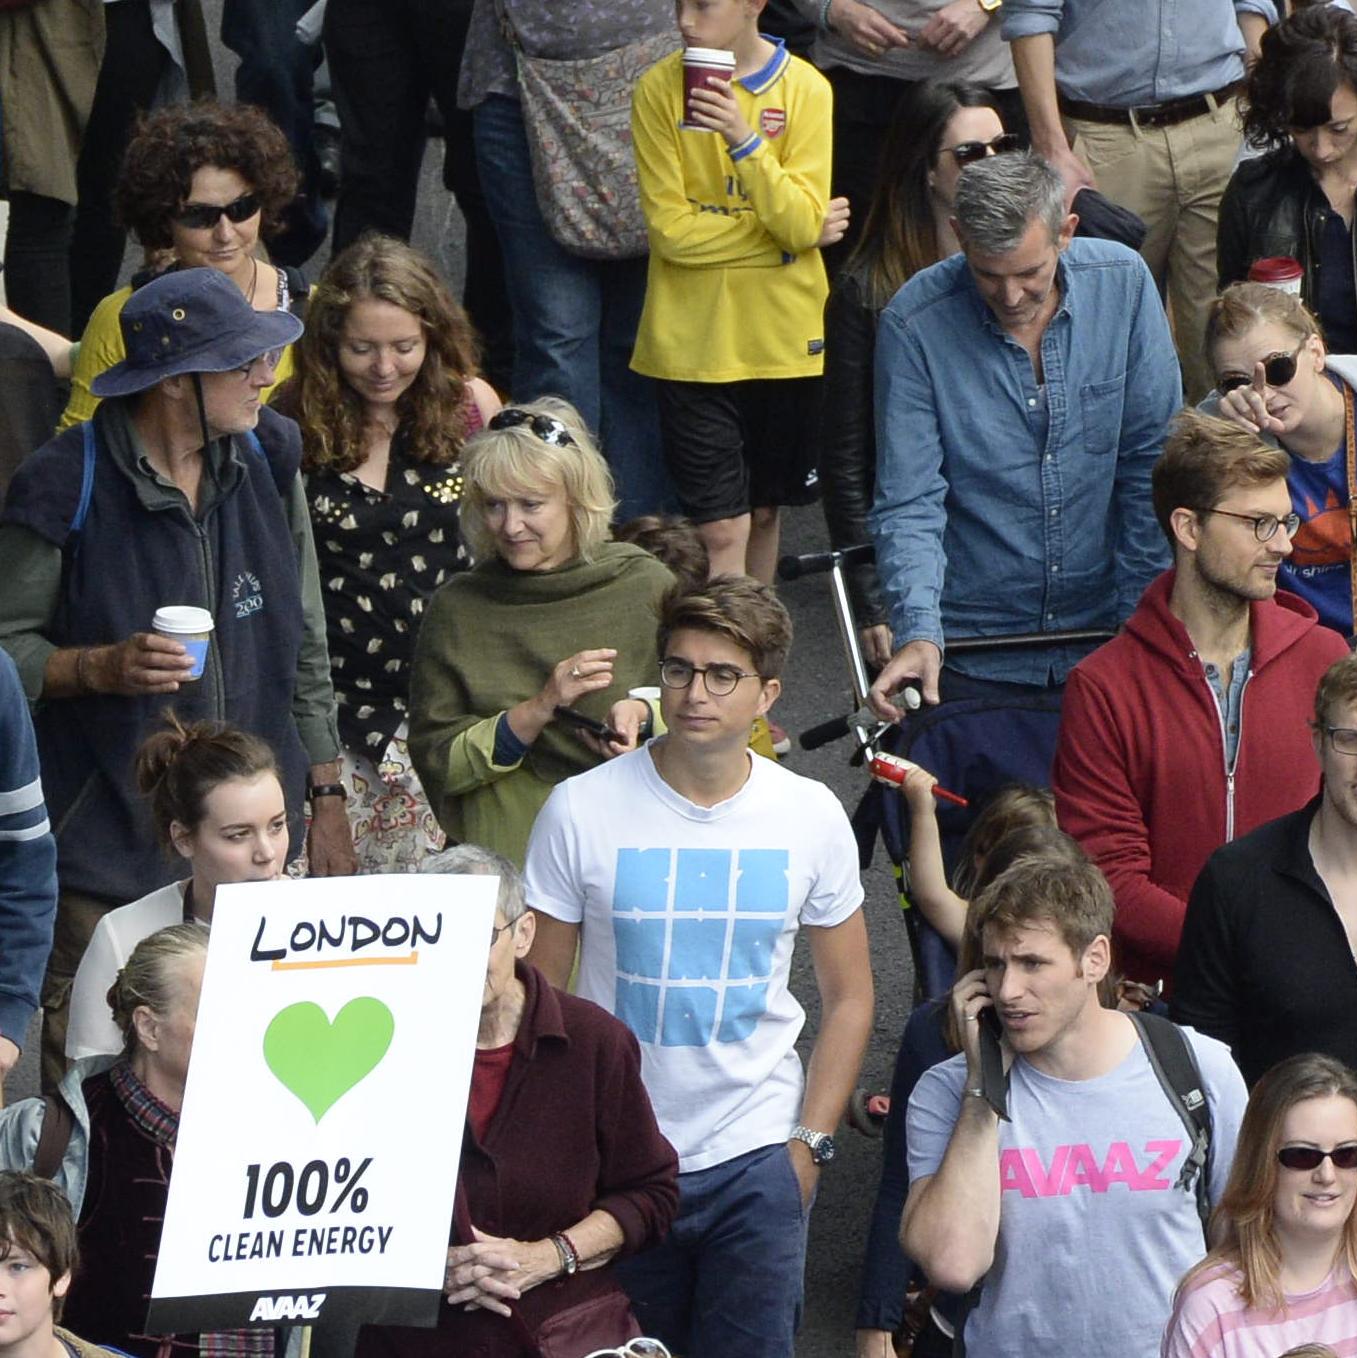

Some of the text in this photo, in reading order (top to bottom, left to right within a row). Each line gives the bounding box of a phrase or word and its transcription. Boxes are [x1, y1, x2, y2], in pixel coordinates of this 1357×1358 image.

[250, 912, 442, 962] LONDON
[243, 1157, 374, 1219] 100%
[1000, 1139, 1182, 1198] AVAAZ
[208, 1225, 393, 1263] CLEAN ENERGY
[249, 1294, 327, 1322] AVAAZ
